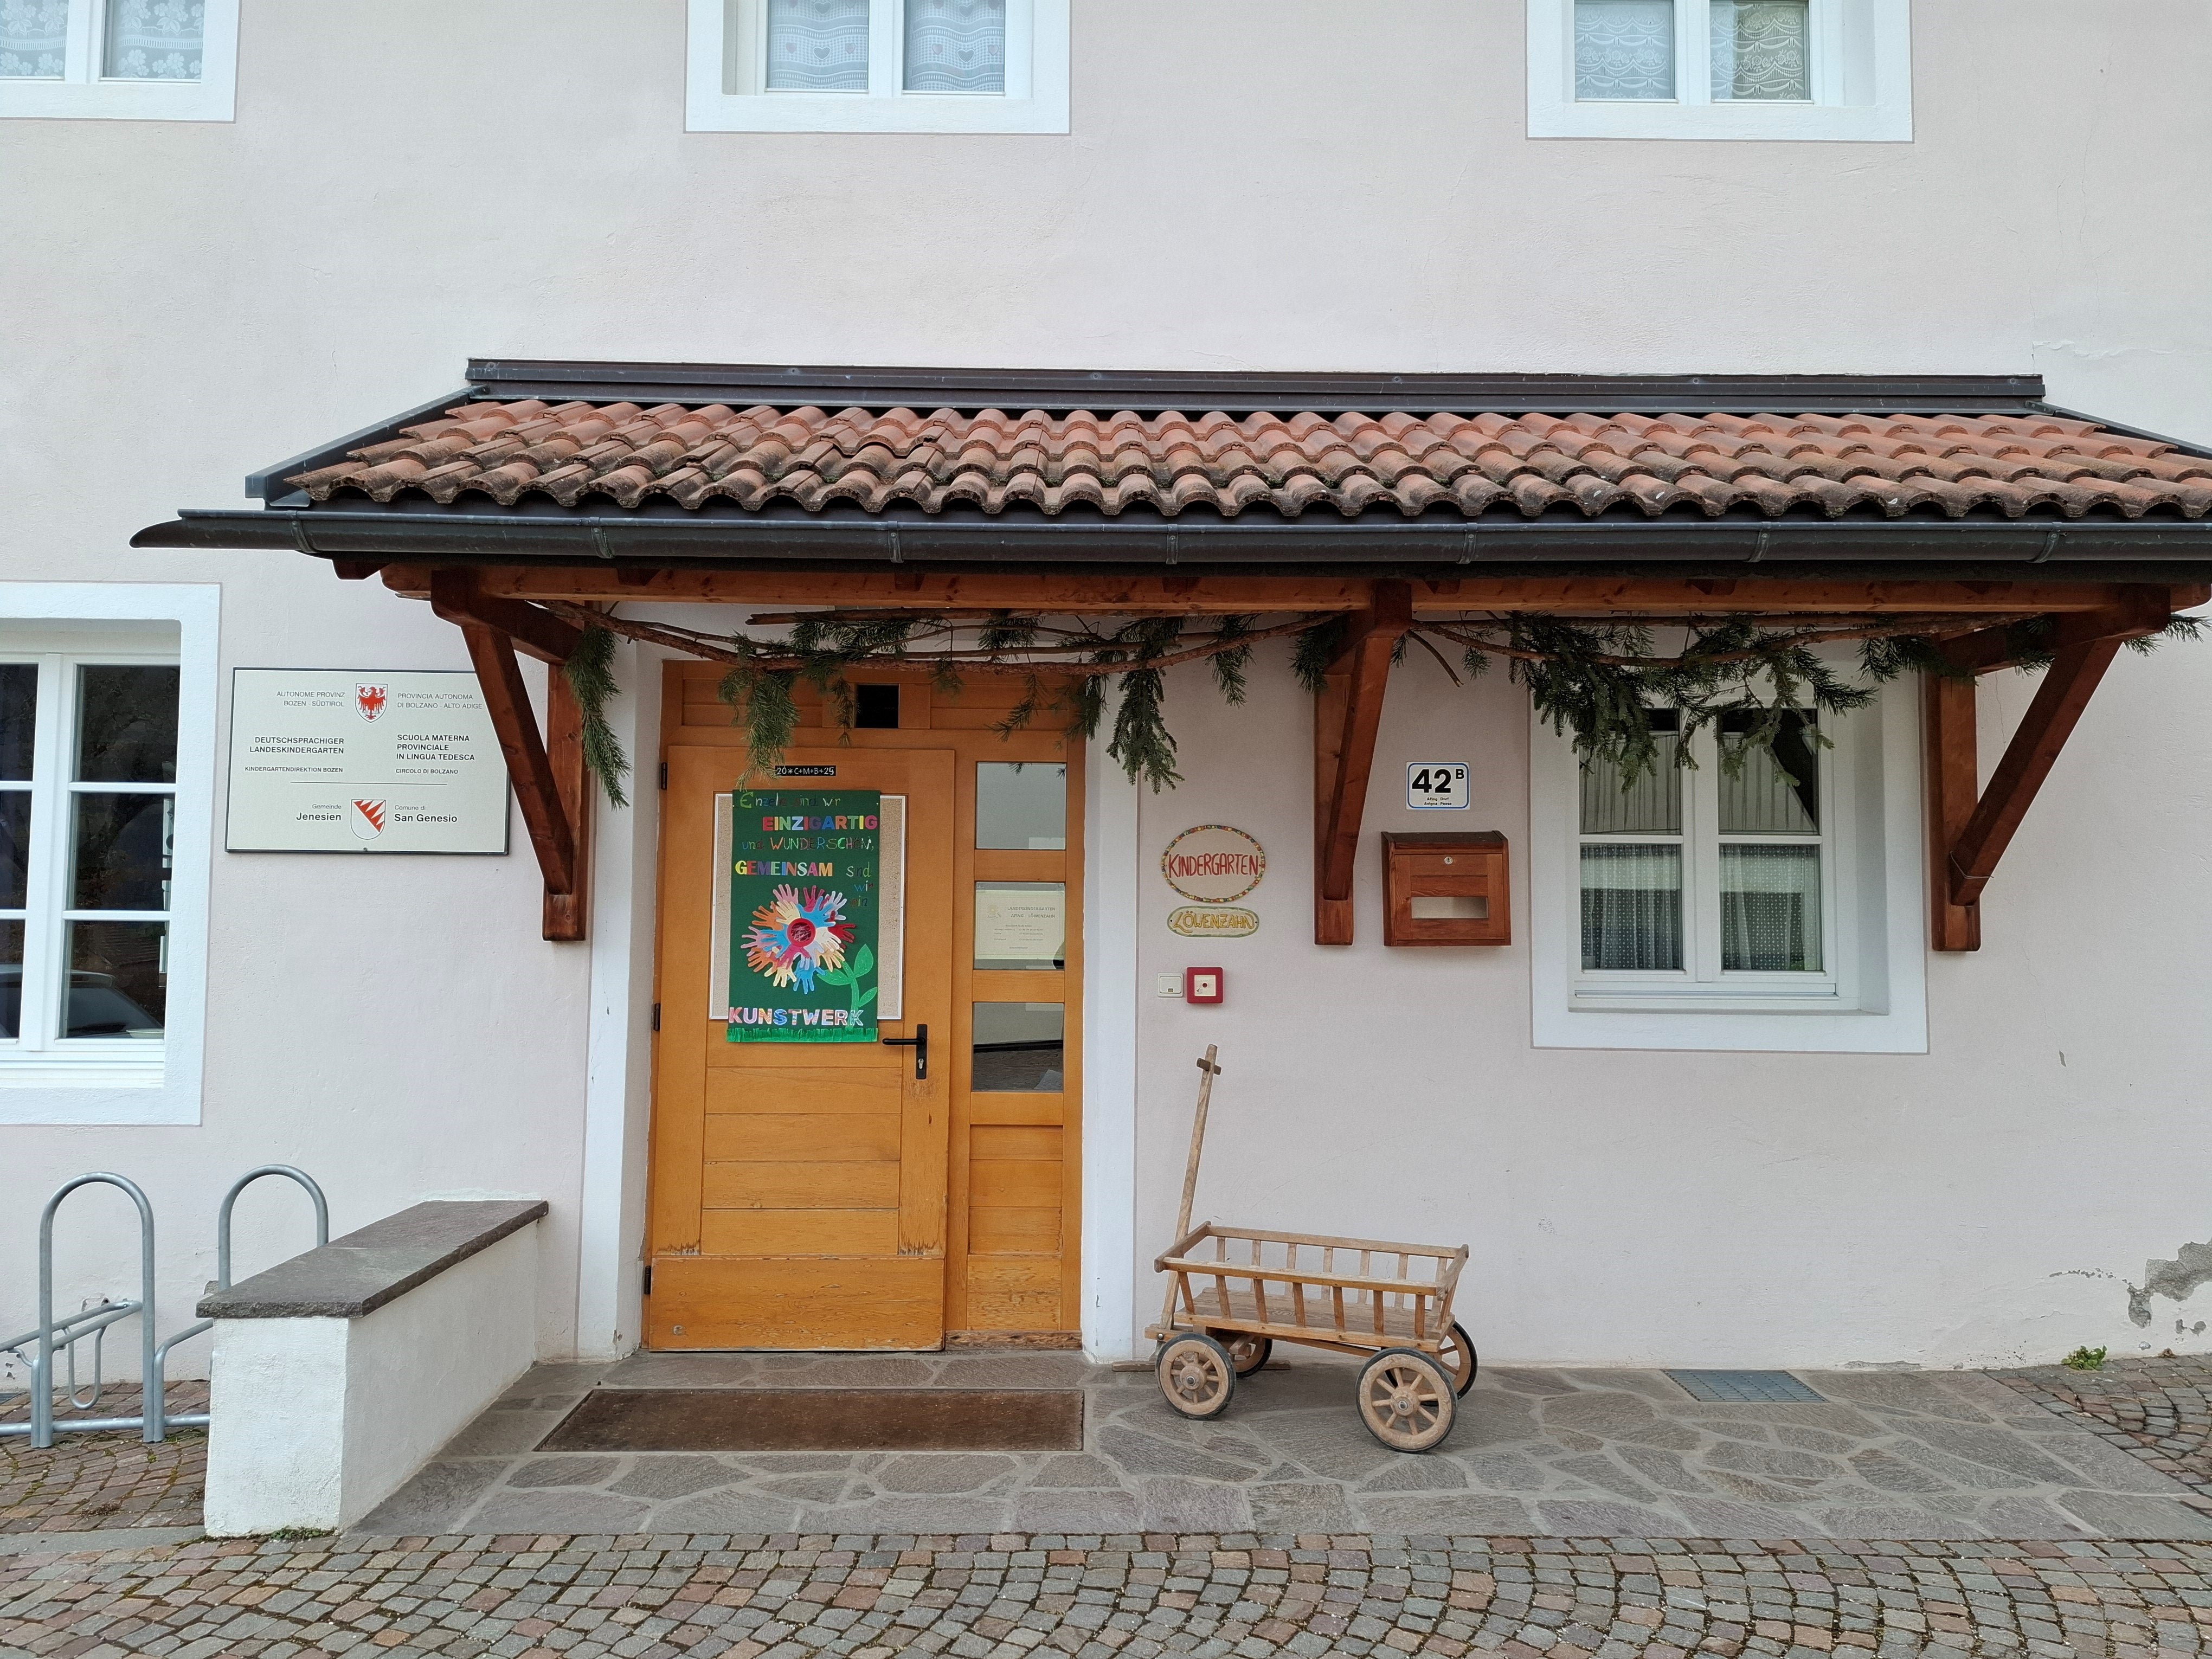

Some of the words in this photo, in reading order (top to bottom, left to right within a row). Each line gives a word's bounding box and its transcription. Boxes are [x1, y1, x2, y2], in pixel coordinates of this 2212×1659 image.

[249, 746, 344, 754] LANDESKINDERGARTEN
[823, 796, 841, 807] wir
[296, 812, 342, 821] Jenesien
[394, 813, 414, 822] San
[416, 814, 458, 822] Genesio
[762, 815, 878, 831] EINZIGARTIG
[742, 839, 764, 850] und
[735, 860, 833, 877] GEMEINSAM
[1168, 853, 1258, 878] KINDERGARTEN
[854, 880, 874, 892] wir
[850, 895, 868, 907] ein
[1172, 910, 1255, 933] LÖWENZAHN
[729, 1007, 864, 1026] KUNSTWERK
